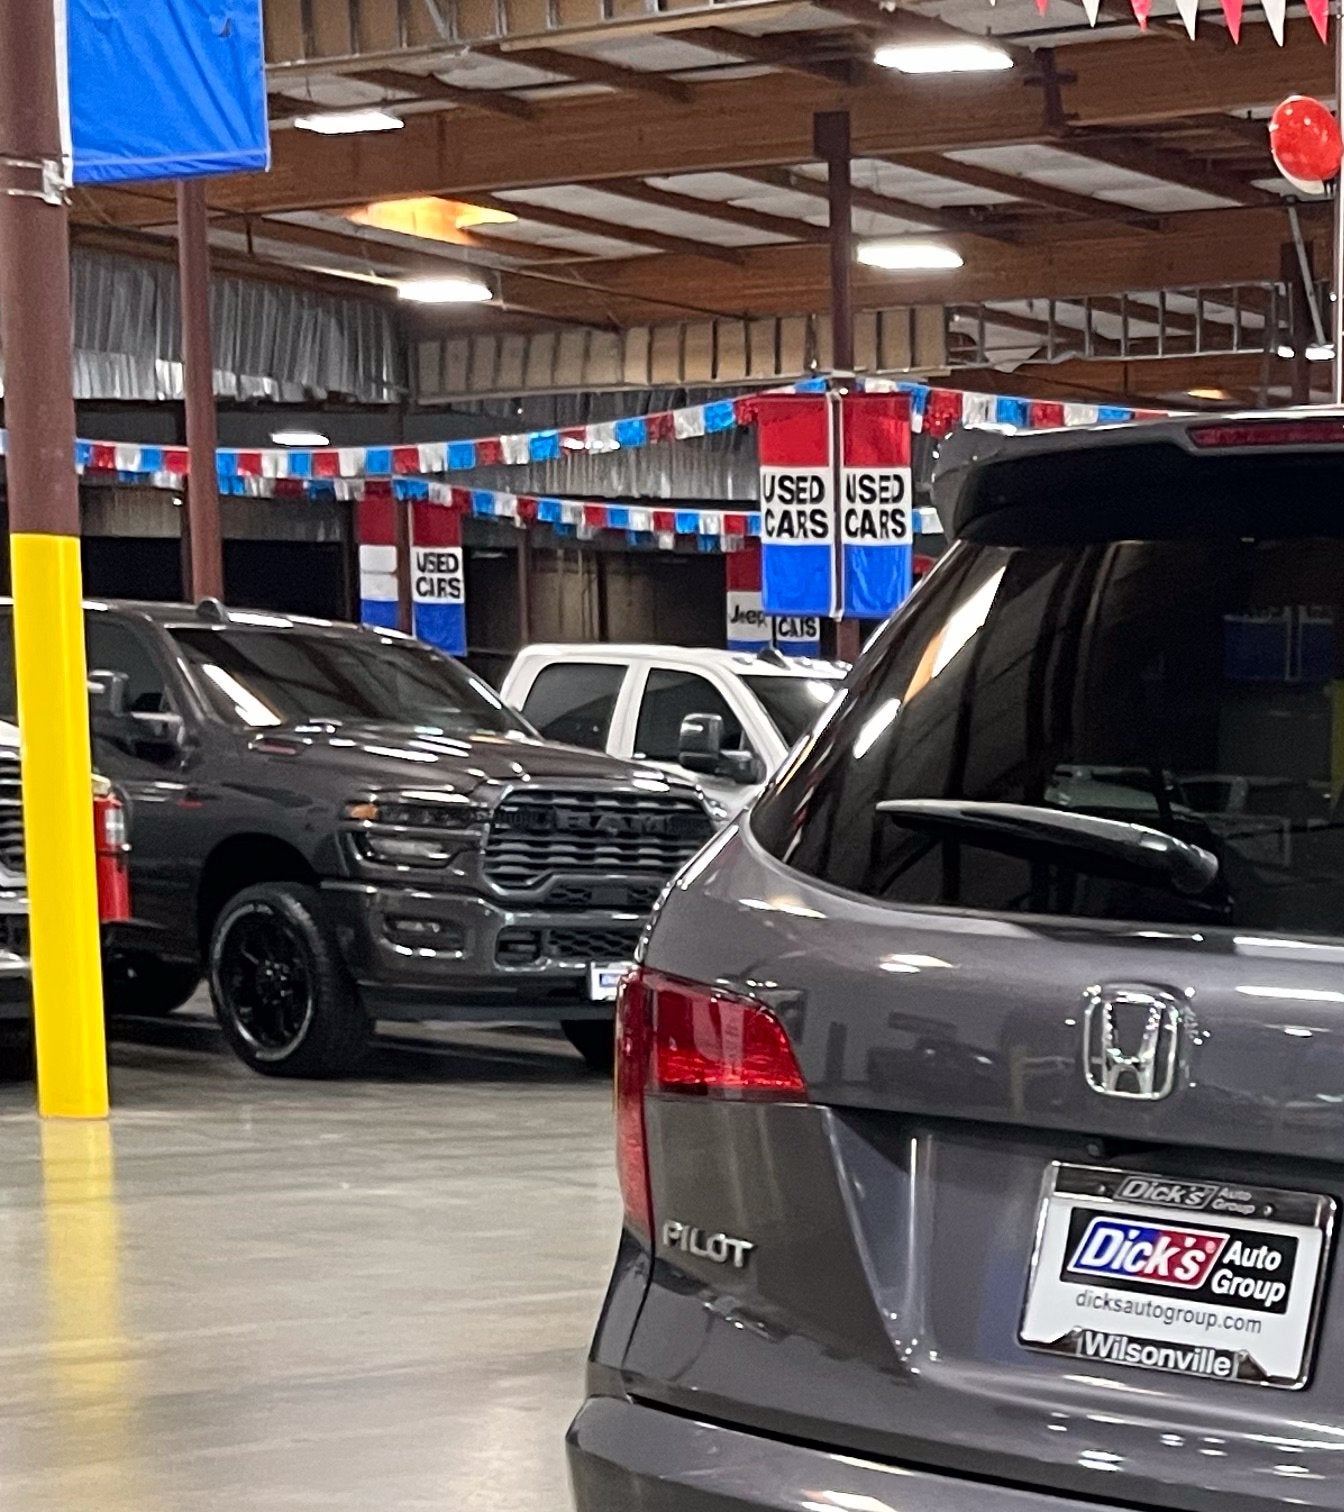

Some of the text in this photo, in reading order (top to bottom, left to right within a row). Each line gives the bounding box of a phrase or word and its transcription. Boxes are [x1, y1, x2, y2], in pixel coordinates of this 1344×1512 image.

[763, 474, 826, 505] USED
[845, 474, 905, 505] USED
[764, 508, 829, 539] CARS
[844, 508, 907, 539] CARS
[416, 551, 460, 574] USED
[415, 576, 462, 599] CARS
[663, 1219, 754, 1268] PILOT
[1222, 1240, 1282, 1271] Auto
[1210, 1270, 1286, 1307] Group
[1075, 1289, 1262, 1334] dicksautogroup.com
[1084, 1331, 1232, 1376] Wilsonville
